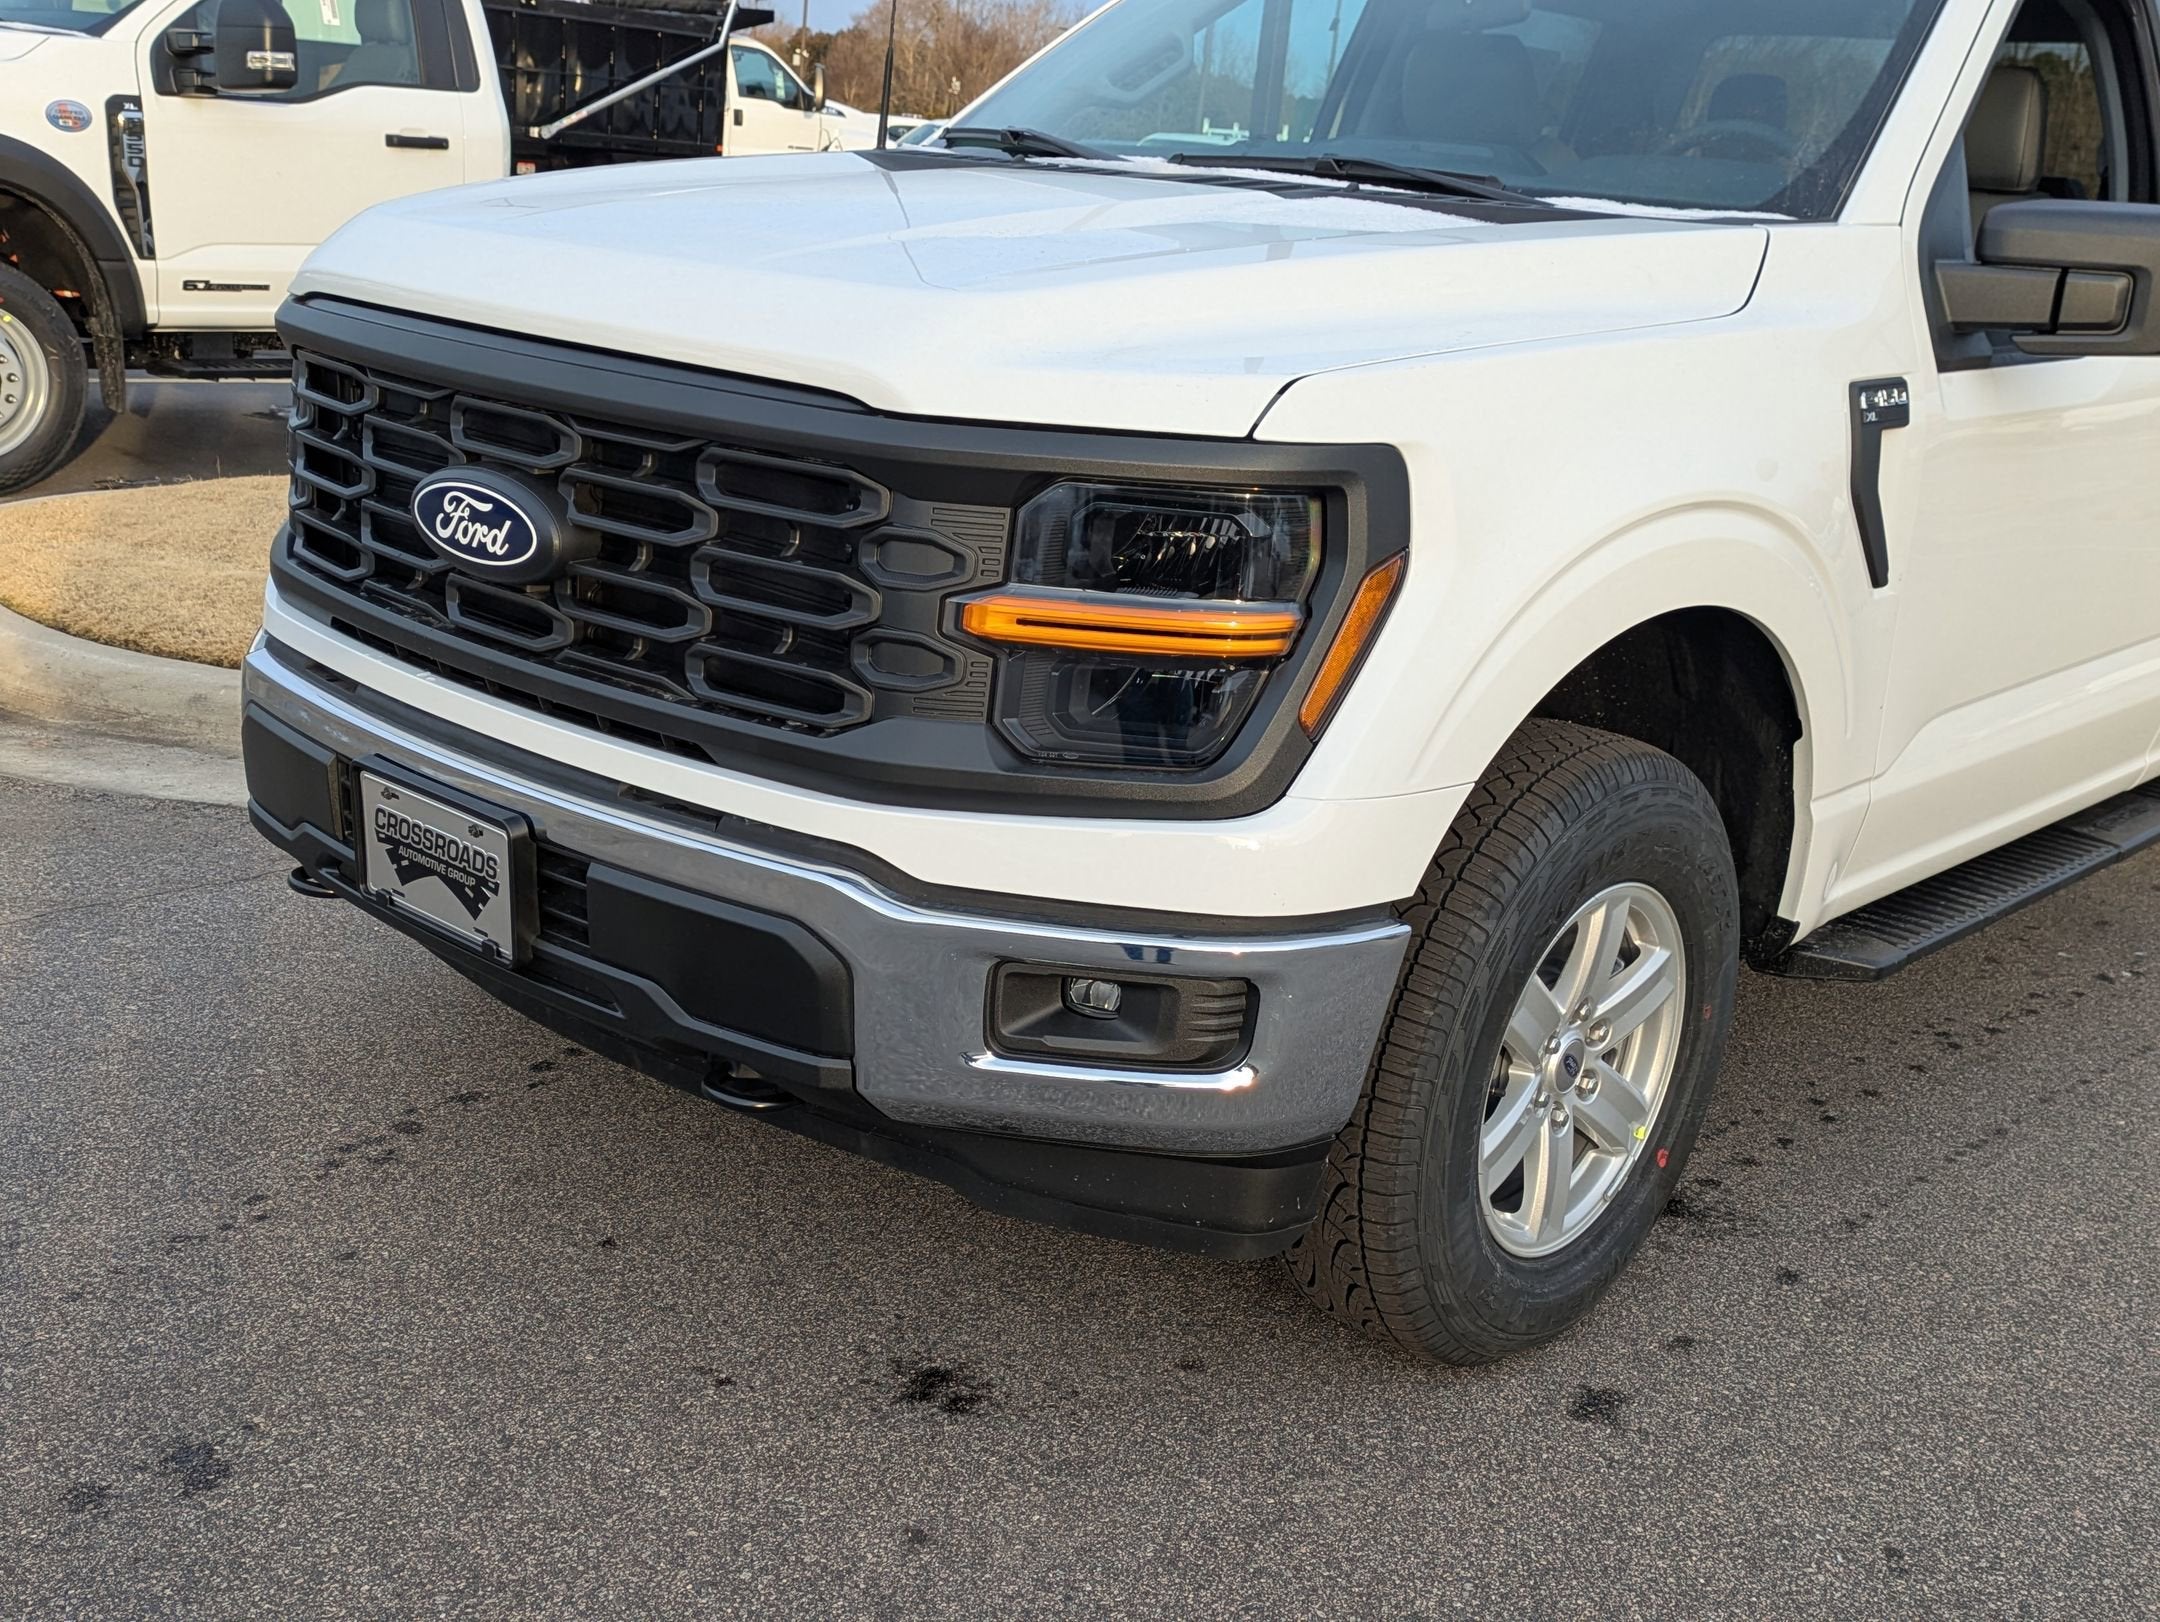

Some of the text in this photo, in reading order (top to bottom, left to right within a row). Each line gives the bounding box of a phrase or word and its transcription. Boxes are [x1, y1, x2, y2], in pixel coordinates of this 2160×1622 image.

[122, 102, 138, 110] XL
[436, 491, 512, 556] Ford
[374, 806, 500, 879] CROSSROADS
[398, 845, 477, 888] AUTOMOTIVE GROUP
